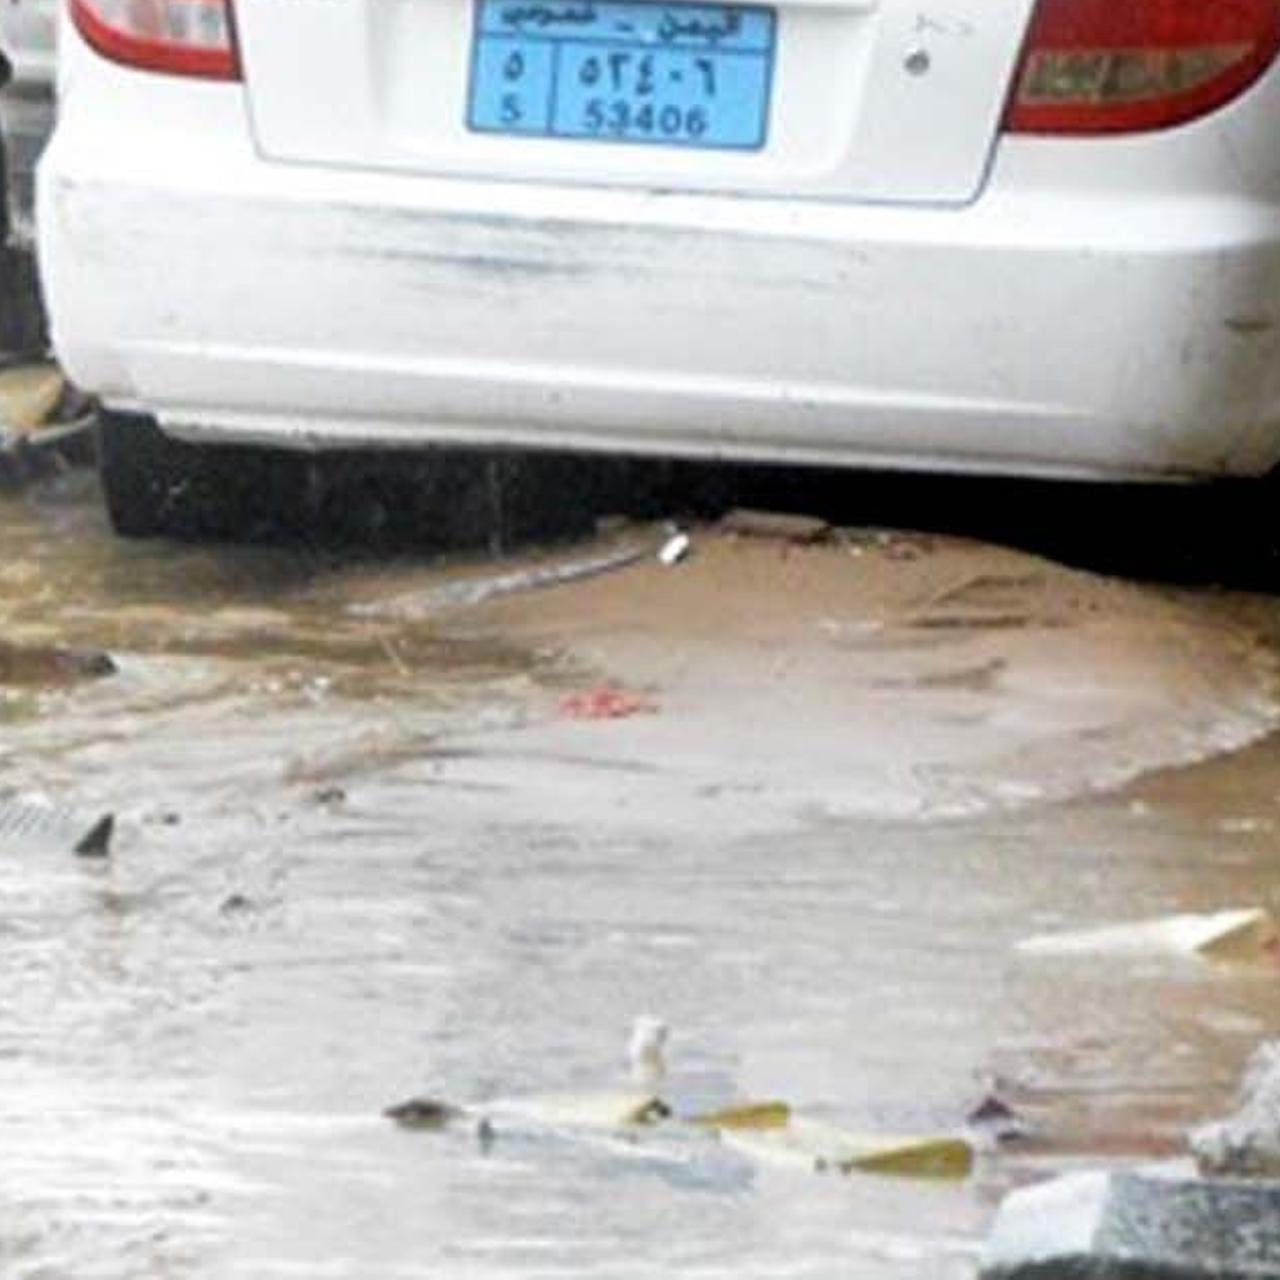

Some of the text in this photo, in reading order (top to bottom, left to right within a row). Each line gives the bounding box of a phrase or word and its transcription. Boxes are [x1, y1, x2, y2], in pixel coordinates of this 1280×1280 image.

[503, 49, 524, 82] ٥
[578, 52, 716, 96] ٥٣٤٠٦
[500, 93, 523, 124] 5
[584, 98, 709, 136] 53406
